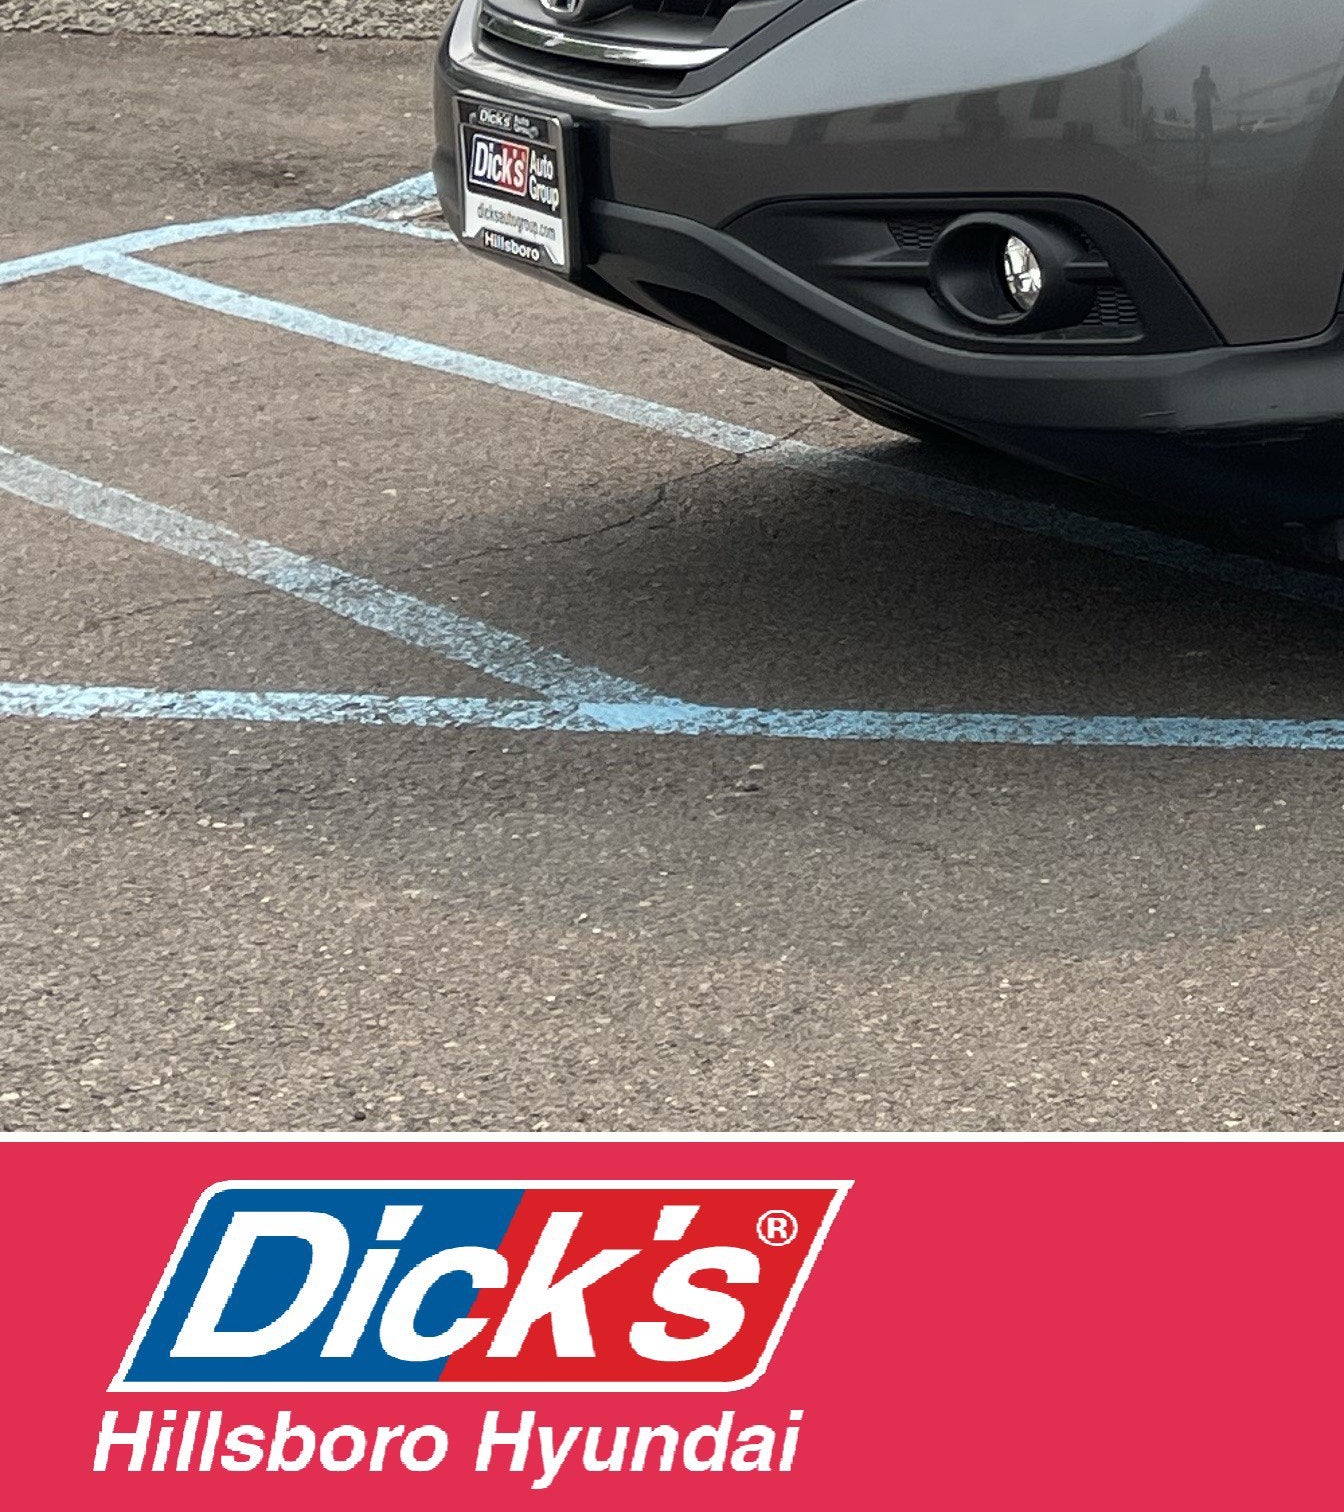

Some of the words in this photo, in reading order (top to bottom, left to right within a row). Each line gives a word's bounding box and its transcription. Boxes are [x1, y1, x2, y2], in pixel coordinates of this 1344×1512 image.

[474, 141, 525, 188] Dick's
[530, 148, 554, 180] Auto
[529, 177, 560, 212] Group
[484, 230, 540, 262] Hillsboro
